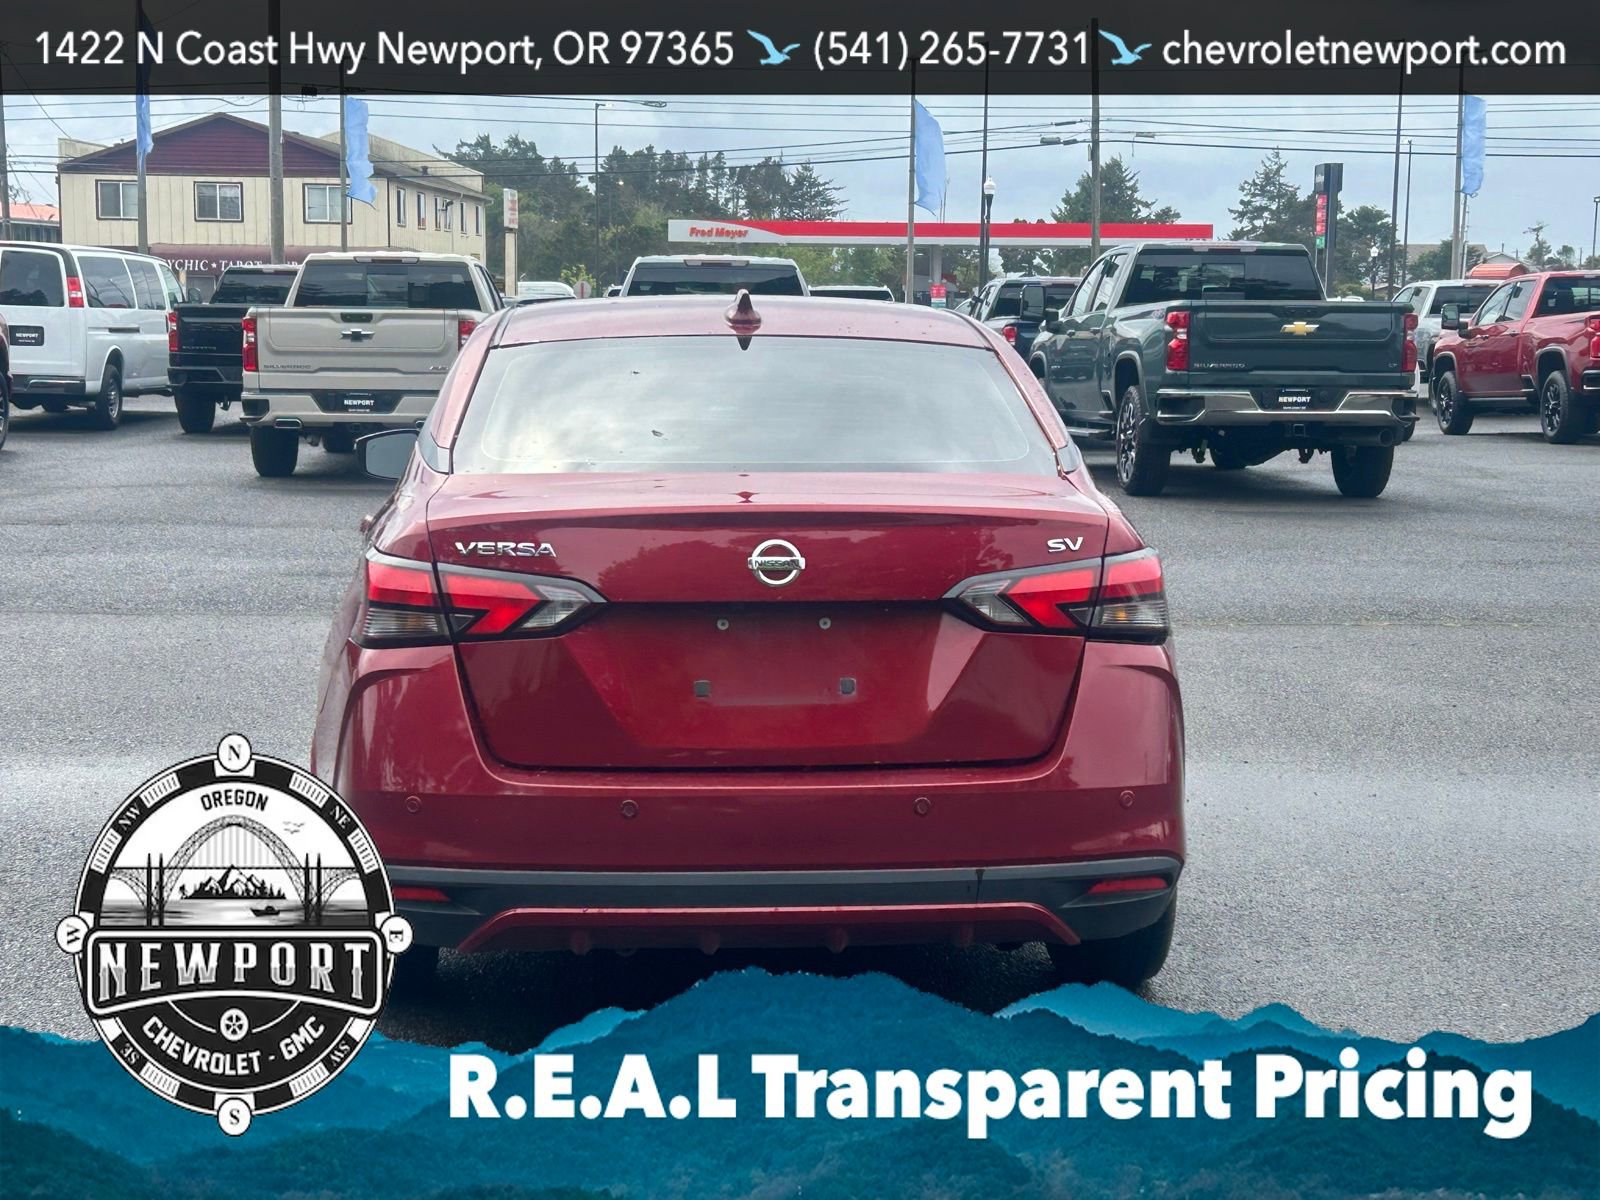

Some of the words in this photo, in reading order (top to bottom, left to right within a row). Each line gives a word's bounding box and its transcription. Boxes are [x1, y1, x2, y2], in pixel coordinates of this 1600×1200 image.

[688, 226, 713, 237] Fred
[715, 226, 748, 239] Meyer
[454, 541, 557, 558] VERSA
[1047, 536, 1084, 553] SV
[754, 559, 801, 569] NISSAN
